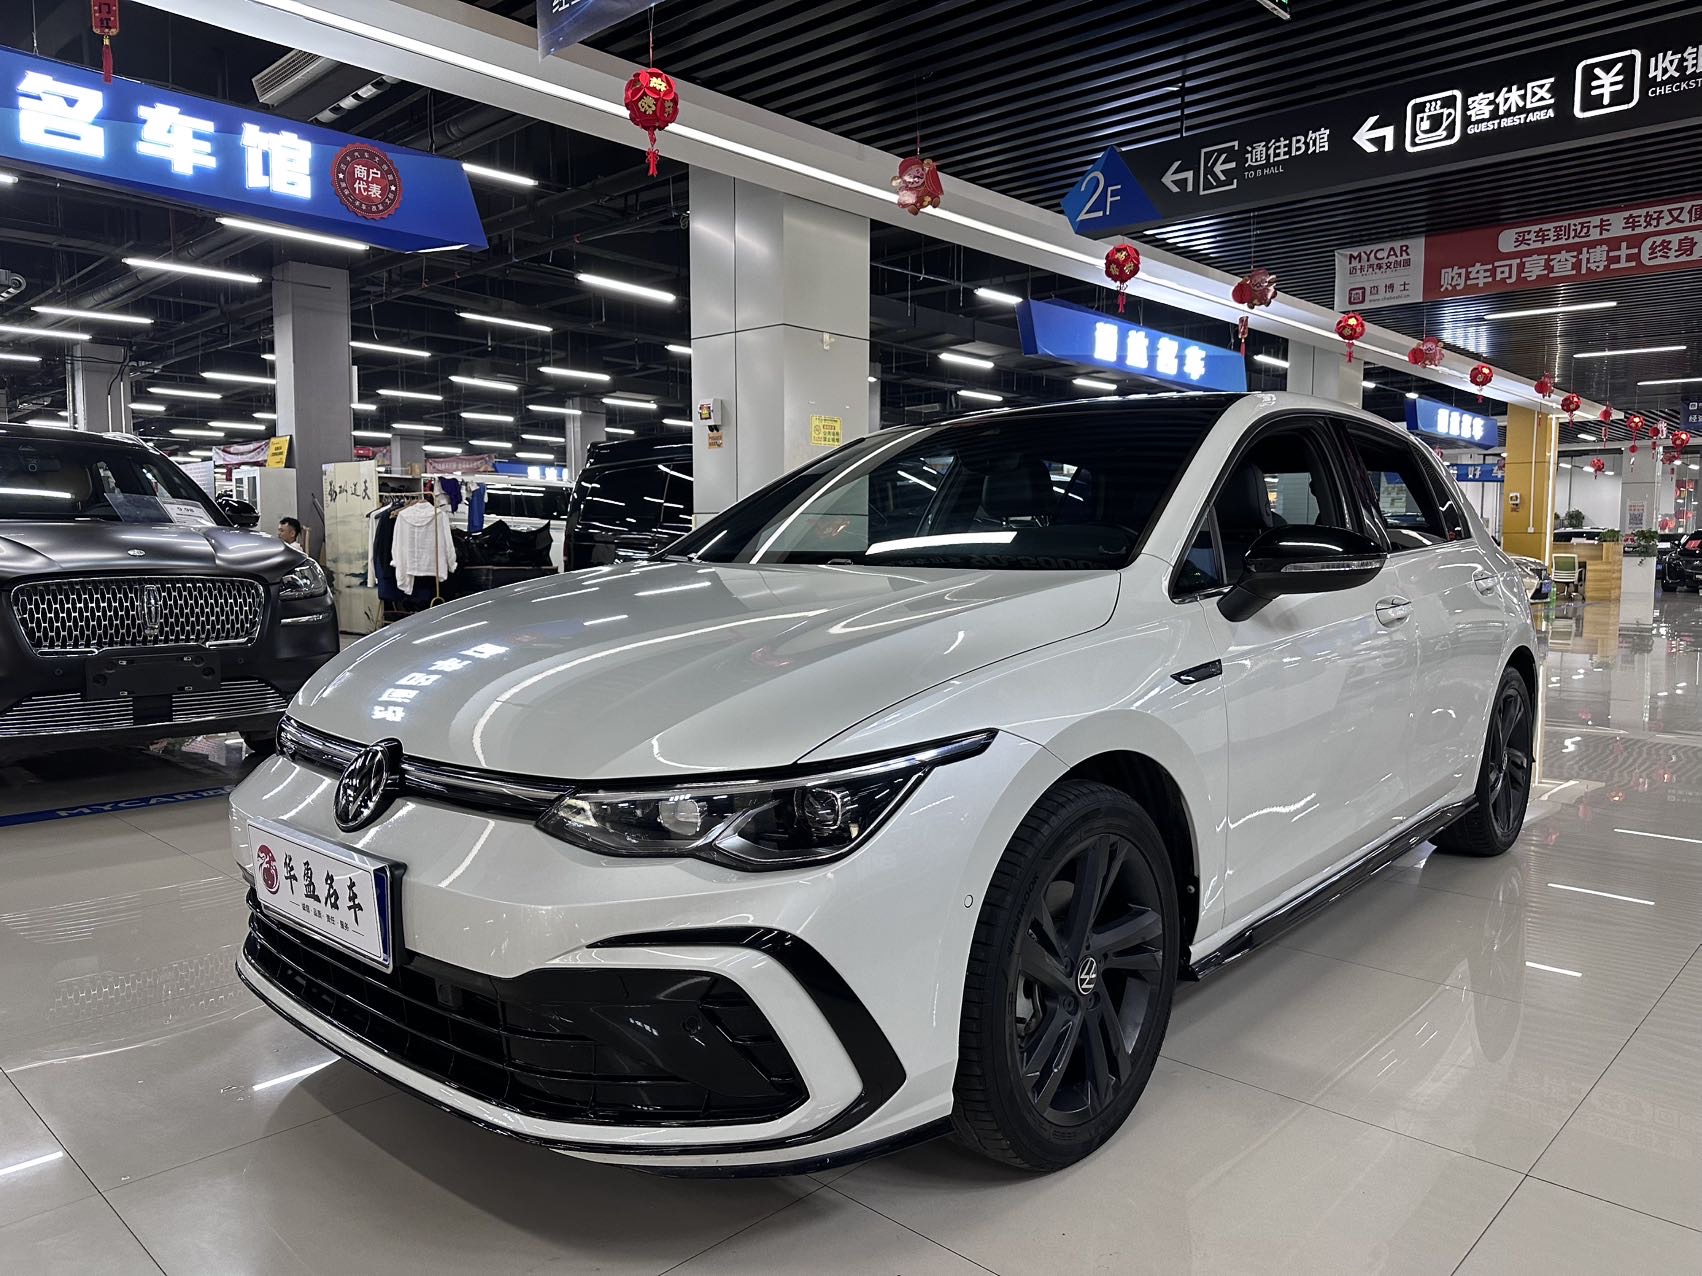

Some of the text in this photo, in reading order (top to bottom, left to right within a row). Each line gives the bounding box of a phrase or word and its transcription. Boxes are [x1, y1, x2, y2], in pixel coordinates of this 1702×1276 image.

[1466, 77, 1555, 122] 客休区
[18, 70, 312, 200] 名车馆
[1466, 108, 1555, 135] GUEST REST AREA
[1245, 128, 1330, 168] 通往B馆
[354, 164, 381, 181] 商户
[1244, 165, 1284, 180] TO B HALL
[354, 180, 382, 199] 代表
[1076, 171, 1122, 221] 2F
[1513, 217, 1612, 249] 买车到迈卡
[1349, 244, 1410, 265] MYCAR
[1440, 236, 1698, 292] 购车可享查博士 终身
[56, 793, 198, 817] MYCAR
